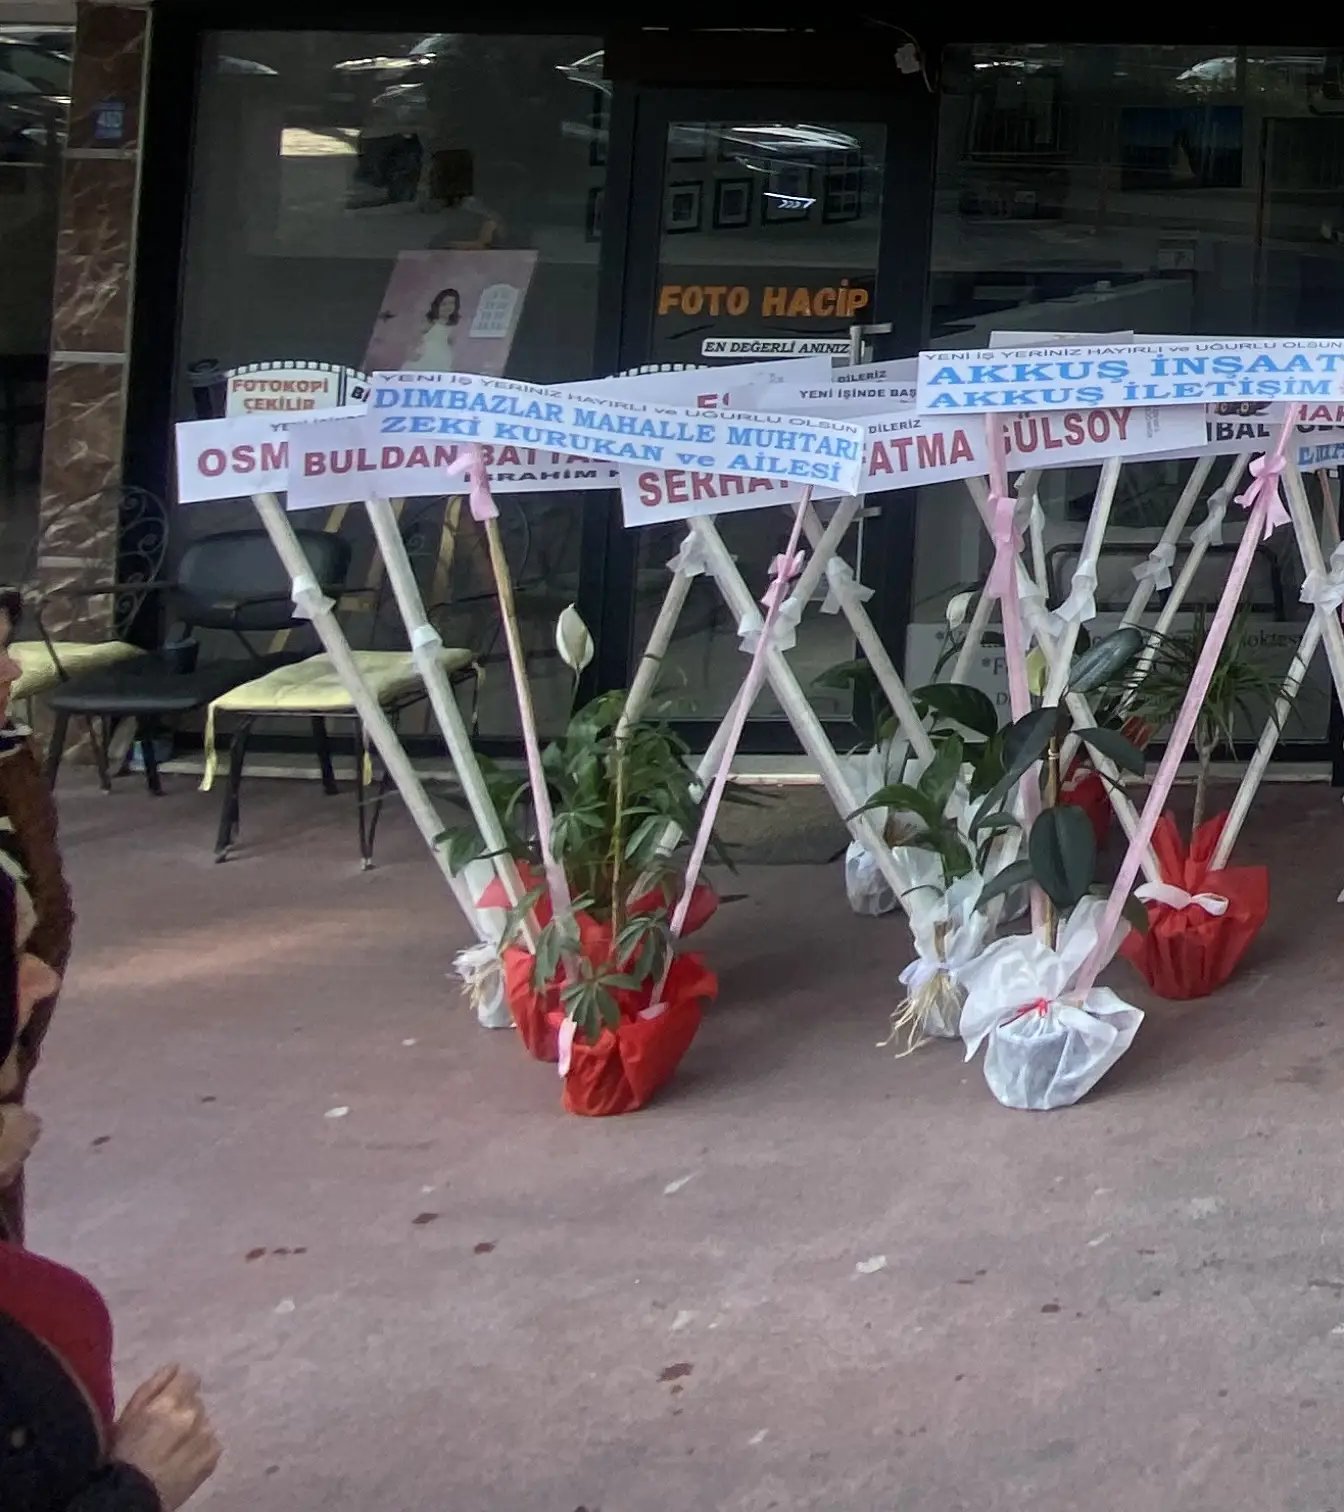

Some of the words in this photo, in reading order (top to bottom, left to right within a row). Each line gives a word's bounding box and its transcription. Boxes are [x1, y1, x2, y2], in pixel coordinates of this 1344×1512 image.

[658, 284, 751, 316] FOTO
[705, 341, 725, 353] EN
[729, 338, 796, 355] DEĞERLİ
[231, 377, 328, 394] FOTOKOPİ
[926, 358, 1130, 386] AKKUŞ
[243, 396, 316, 413] ÇEKİLİR
[926, 385, 1105, 409] AKKUŞ
[1123, 376, 1333, 402] İLETİŞİM
[374, 388, 566, 424] DIMBAZLAR
[572, 407, 716, 444] MAHALLE
[726, 425, 860, 462] MUHTARI
[380, 415, 482, 437] ZEKİ
[494, 422, 665, 462] KURUKAN
[676, 452, 716, 468] ve
[727, 453, 842, 483] AİLESİ
